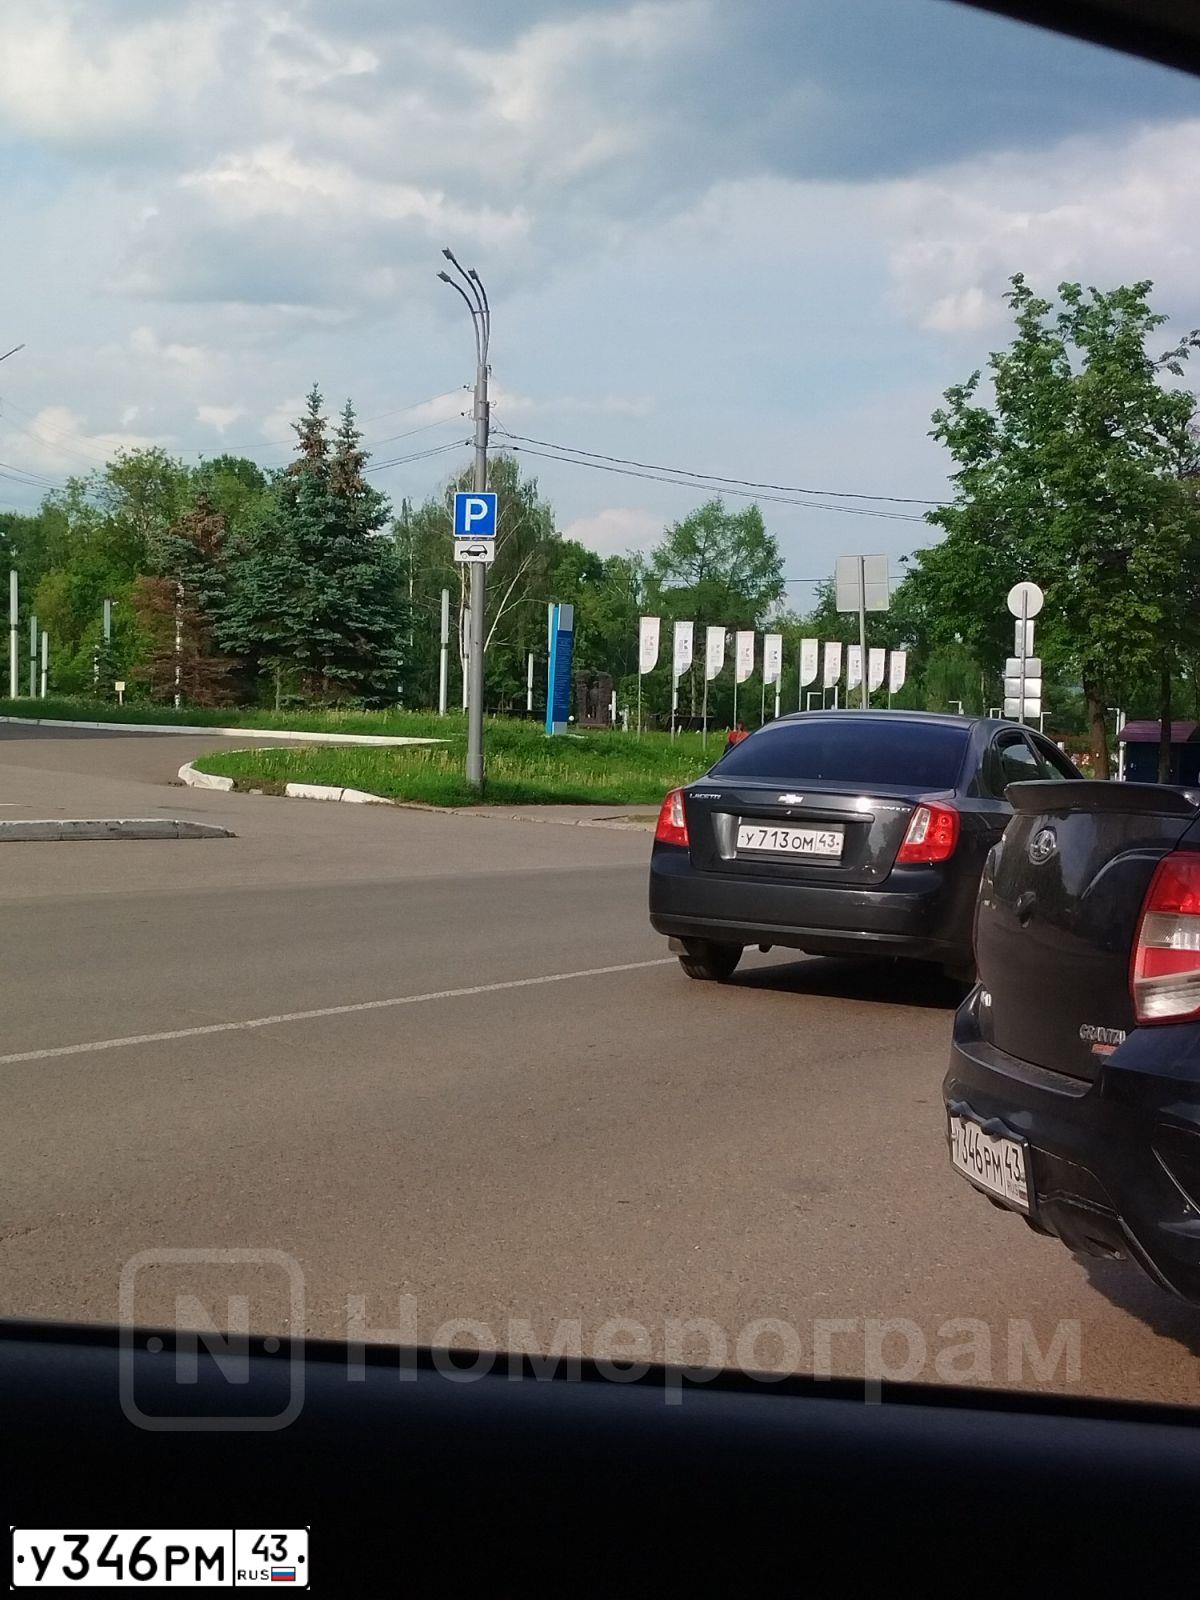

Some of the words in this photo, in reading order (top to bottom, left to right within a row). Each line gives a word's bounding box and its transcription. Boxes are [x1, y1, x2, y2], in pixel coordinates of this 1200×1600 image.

[465, 498, 488, 531] P
[818, 833, 836, 848] 43
[1005, 1144, 1021, 1182] 43
